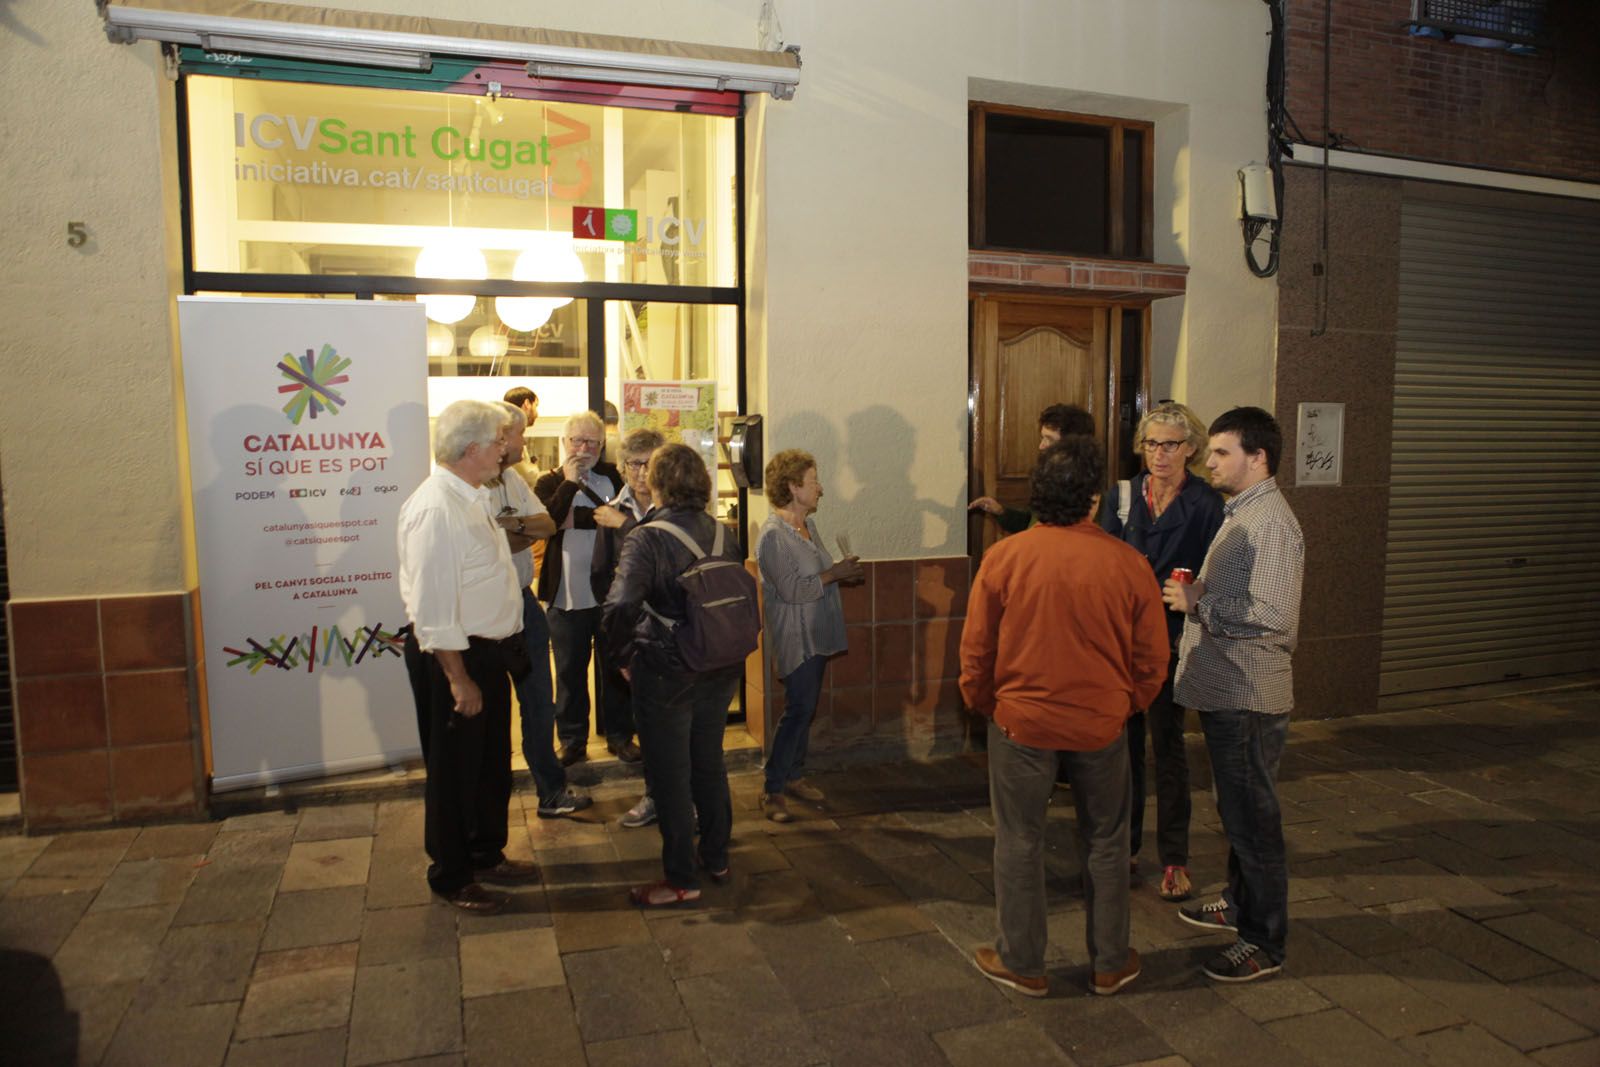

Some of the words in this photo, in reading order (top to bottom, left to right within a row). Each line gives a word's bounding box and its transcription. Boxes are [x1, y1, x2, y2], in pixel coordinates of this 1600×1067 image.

[432, 126, 552, 170] Cugat
[235, 158, 557, 200] iniciativa.cat/santcugat
[68, 221, 87, 248] 5
[647, 217, 706, 246] ICV
[243, 432, 386, 453] CATALUNYA
[245, 458, 263, 476] SÍ
[269, 459, 312, 476] QUE
[319, 458, 343, 473] ES
[350, 457, 388, 472] POT
[235, 490, 275, 500] PODEM
[309, 489, 327, 497] ICV
[374, 485, 399, 494] equo
[263, 519, 379, 532] catalunyasiqueespot.cat
[255, 582, 273, 590] PEL
[275, 579, 307, 589] CANVI
[310, 576, 346, 586] SOCIAL
[354, 571, 393, 582] POLÍTIC
[293, 592, 300, 600] A
[302, 587, 358, 599] CATALUNYA
